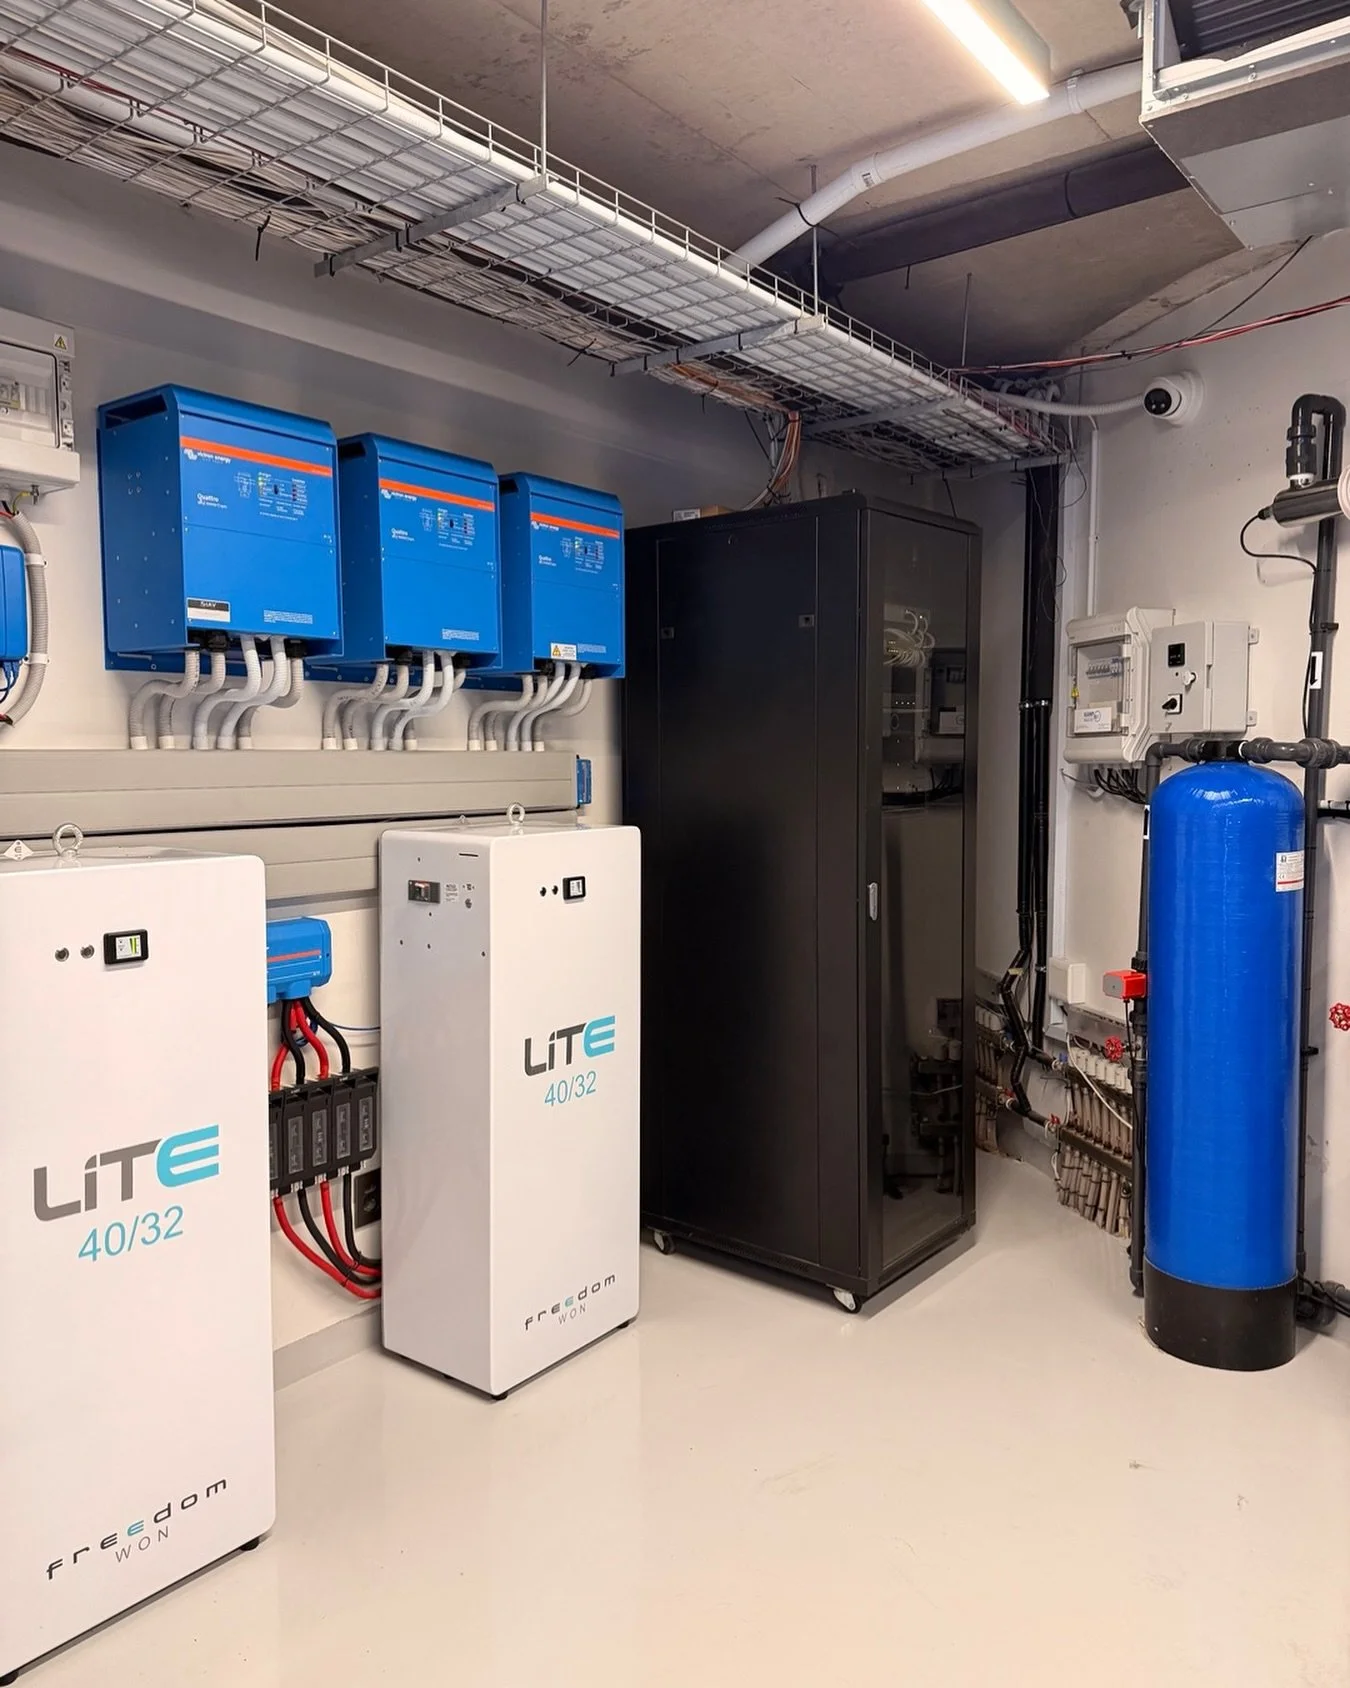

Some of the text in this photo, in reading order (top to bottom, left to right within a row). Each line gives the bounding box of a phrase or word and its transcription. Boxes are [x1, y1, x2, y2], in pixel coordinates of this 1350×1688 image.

[544, 1070, 597, 1107] 40/32
[78, 1205, 184, 1262] 40/32
[558, 1302, 586, 1325] WON
[115, 1526, 169, 1563] WON
